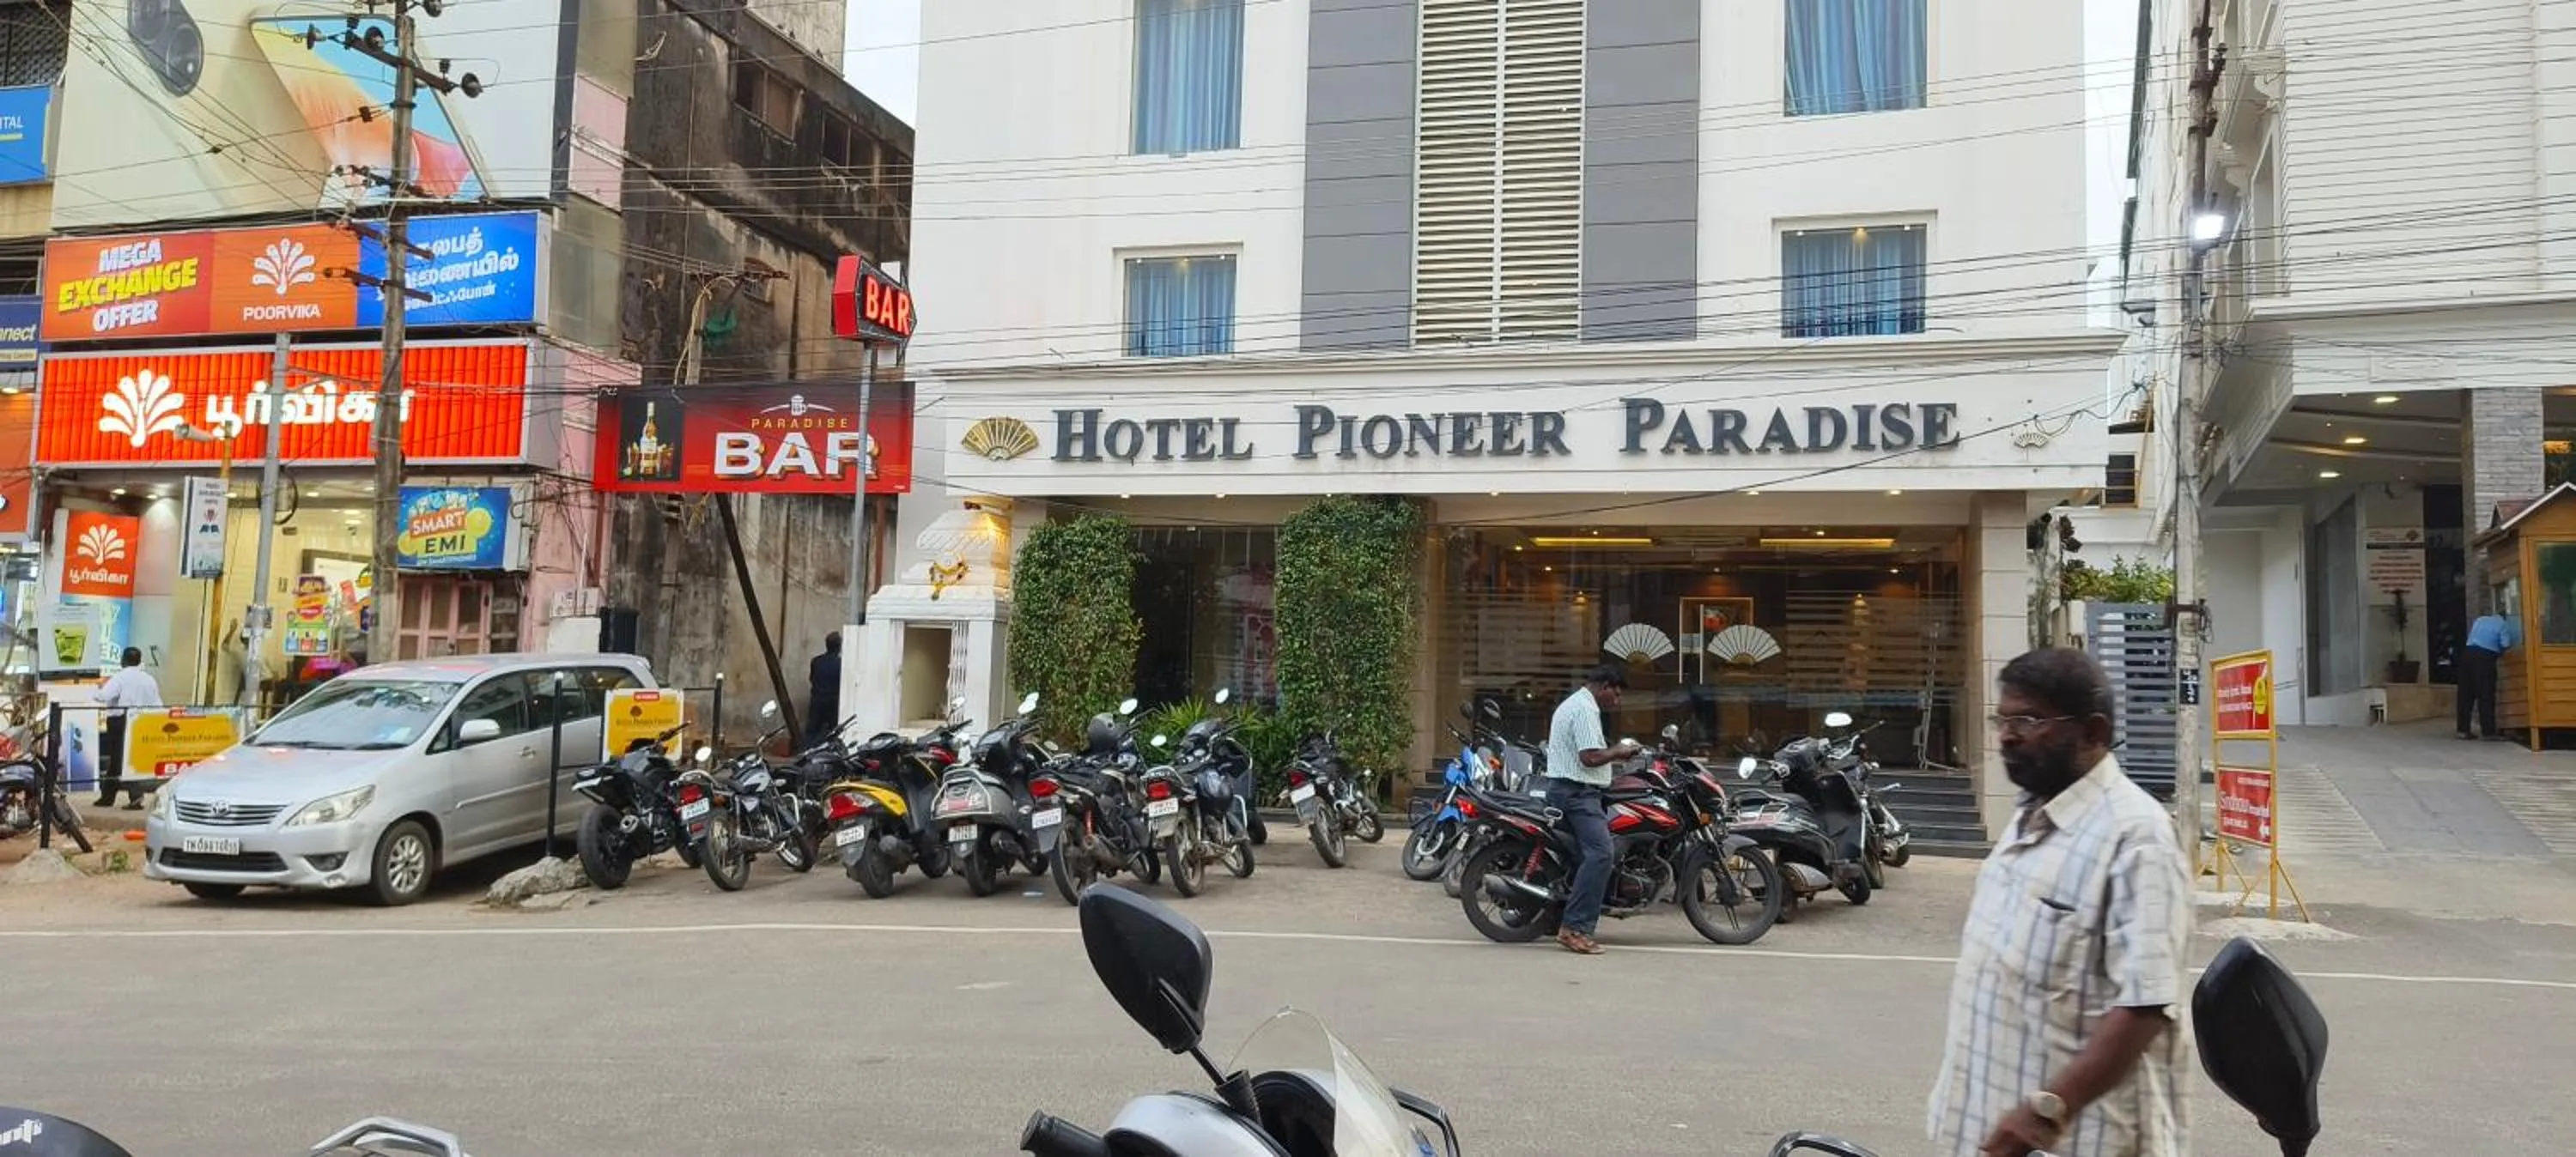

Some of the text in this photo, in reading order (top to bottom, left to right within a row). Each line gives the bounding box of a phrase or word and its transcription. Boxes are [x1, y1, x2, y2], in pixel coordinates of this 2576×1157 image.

[99, 238, 162, 272] MEGA
[58, 257, 198, 312] EXCHANGE
[93, 300, 159, 331] OFFER
[243, 304, 322, 321] POORVIKA
[866, 276, 909, 336] BAR
[751, 418, 849, 429] PARADISE
[1050, 397, 1960, 462] HOTEL PIONEER PARADISE
[714, 432, 880, 480] BAR
[411, 511, 465, 536] SMART
[424, 535, 466, 554] EMI
